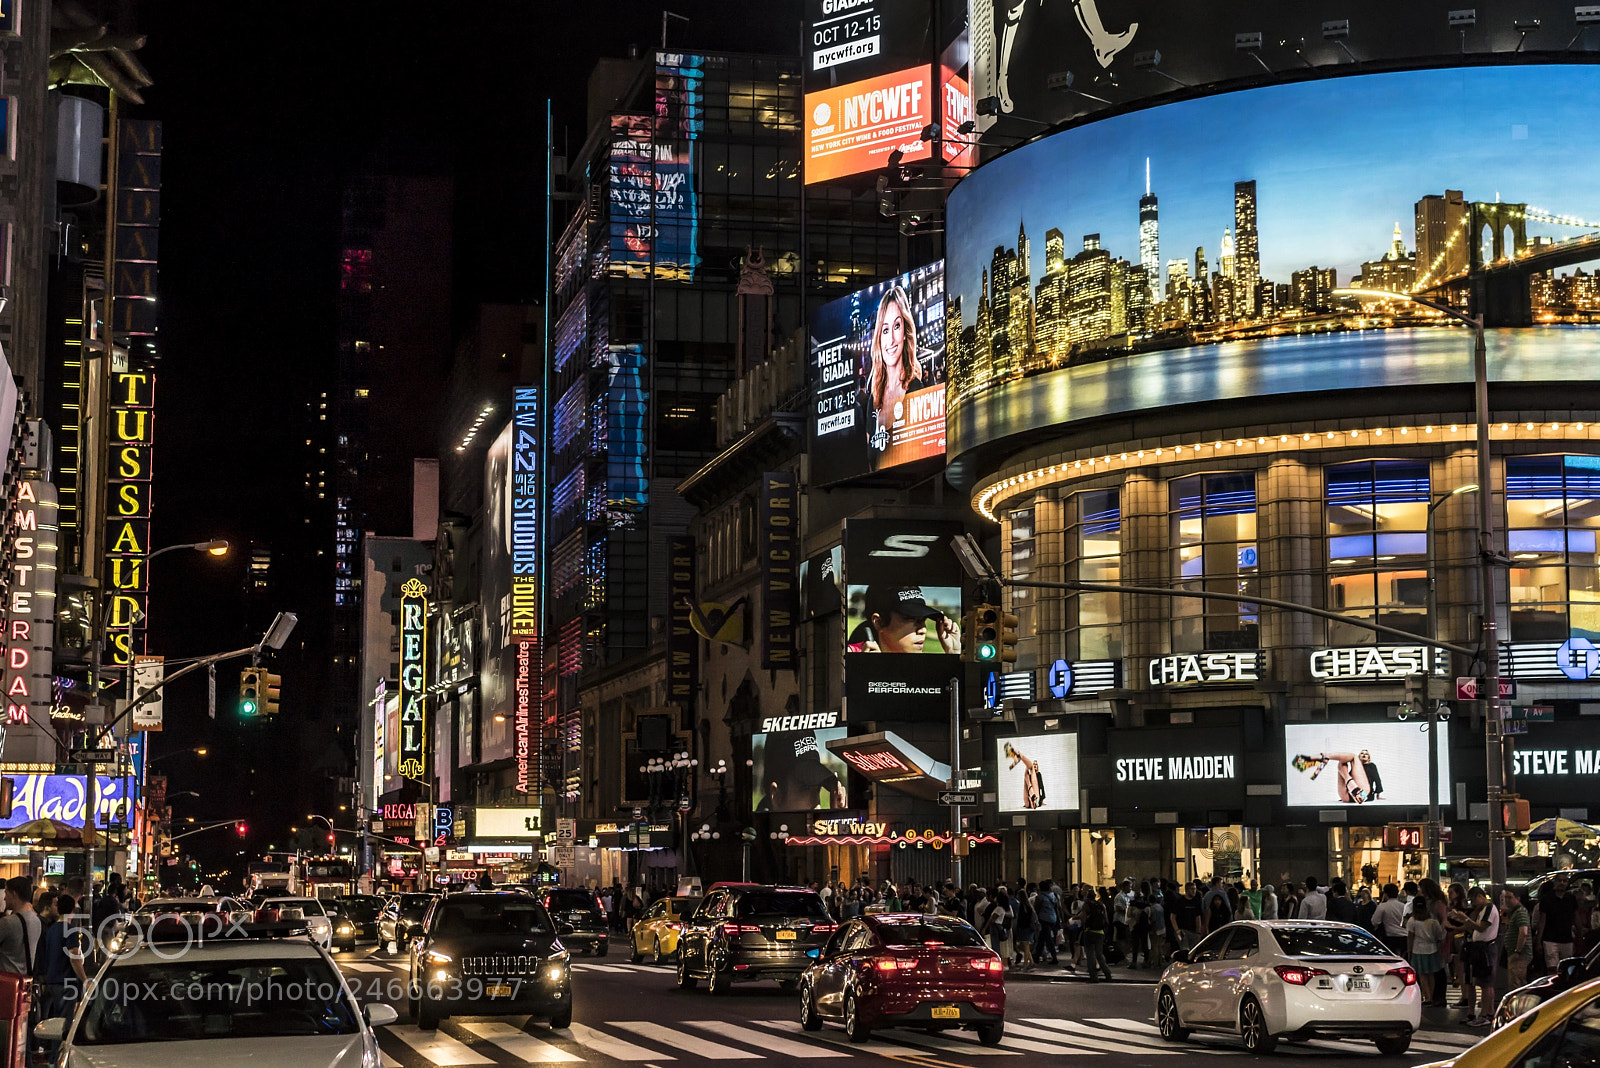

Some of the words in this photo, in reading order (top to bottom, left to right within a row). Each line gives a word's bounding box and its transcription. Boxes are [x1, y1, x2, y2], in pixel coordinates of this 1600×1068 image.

[814, 26, 840, 46] OCT
[844, 15, 881, 38] 12-15
[819, 42, 874, 64] nycwff.org
[844, 80, 923, 130] NYCWFF
[811, 144, 825, 152] NEW
[825, 139, 841, 149] YORK
[842, 136, 855, 145] CITY
[856, 132, 872, 142] WINE
[872, 131, 877, 139] &
[878, 127, 894, 137] FOOD
[895, 121, 923, 133] FESTIVAL
[818, 345, 843, 368] MEET
[823, 358, 854, 383] GIADA!
[515, 388, 537, 427] NEW
[818, 397, 833, 414] OCT
[835, 391, 856, 410] 12-15
[820, 414, 852, 431] nycwff.org
[515, 429, 536, 471] 42
[513, 498, 536, 574] STUDIOS
[770, 480, 790, 591] VICTORY
[6, 481, 37, 725] AMSTERDAM
[672, 542, 691, 636] VICTORY
[512, 583, 535, 628] DUKE
[770, 610, 790, 662] NEW
[403, 604, 424, 752] REGAL
[672, 651, 691, 695] NEW
[1149, 653, 1259, 685] CHASE
[1466, 684, 1483, 693] ONE
[762, 712, 838, 733] SKECHERS
[1523, 708, 1529, 718] 7
[1117, 758, 1163, 781] STEVE
[1169, 755, 1234, 780] MADDEN
[1513, 750, 1568, 775] STEVE
[12, 774, 132, 821] Aladdin
[559, 829, 572, 838] 25
[890, 830, 897, 839] A
[926, 830, 933, 839] R
[900, 841, 907, 849] C
[917, 841, 924, 849] E
[934, 840, 941, 848] W
[969, 840, 976, 848] S
